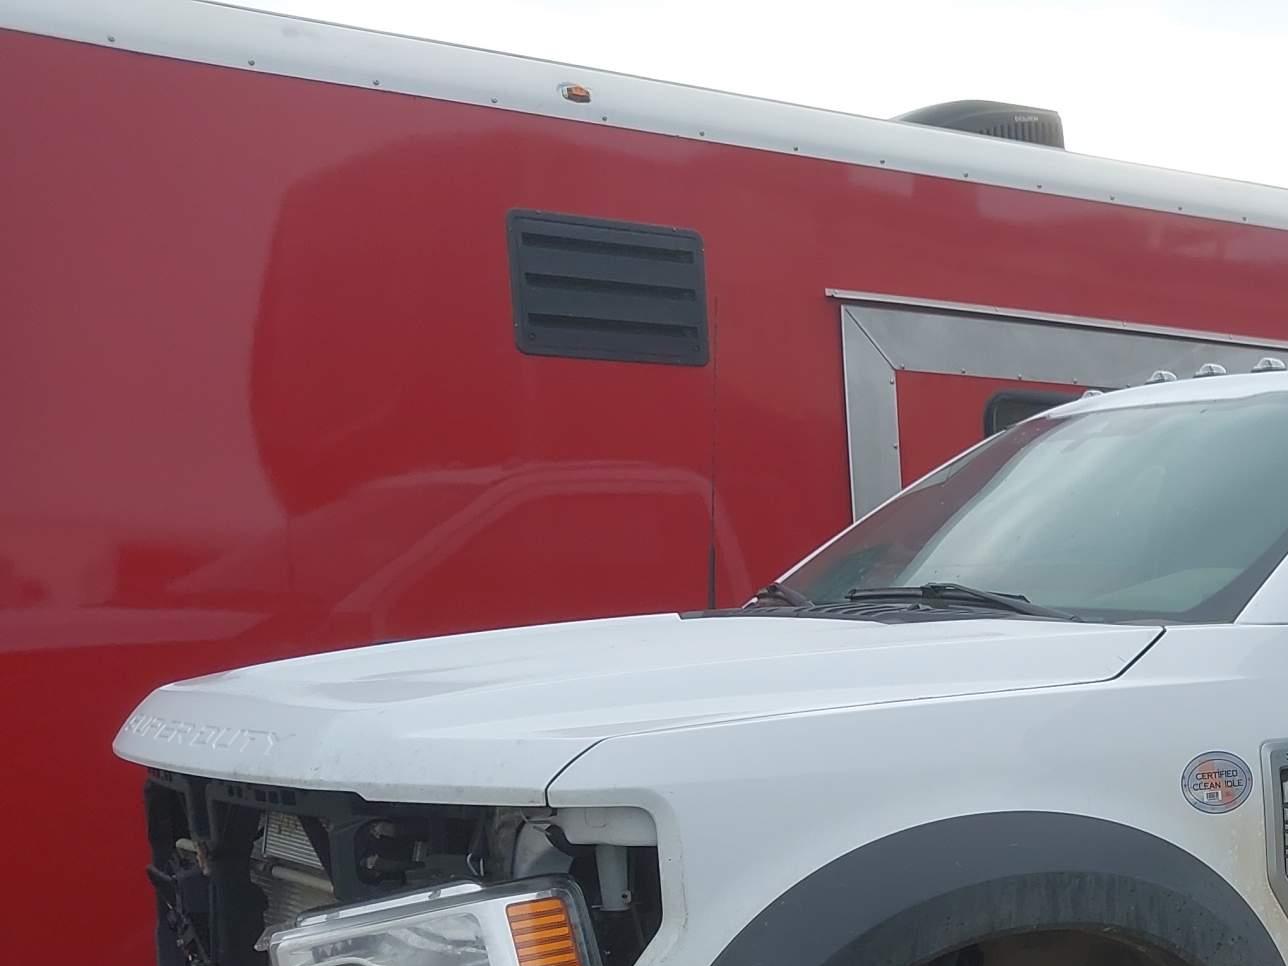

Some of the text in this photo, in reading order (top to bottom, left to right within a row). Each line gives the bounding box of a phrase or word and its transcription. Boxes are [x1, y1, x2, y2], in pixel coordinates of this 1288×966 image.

[125, 713, 281, 755] SUPER DUTY
[1195, 769, 1238, 780] CERTIFIED
[1192, 779, 1244, 791] CLEAN IDLE
